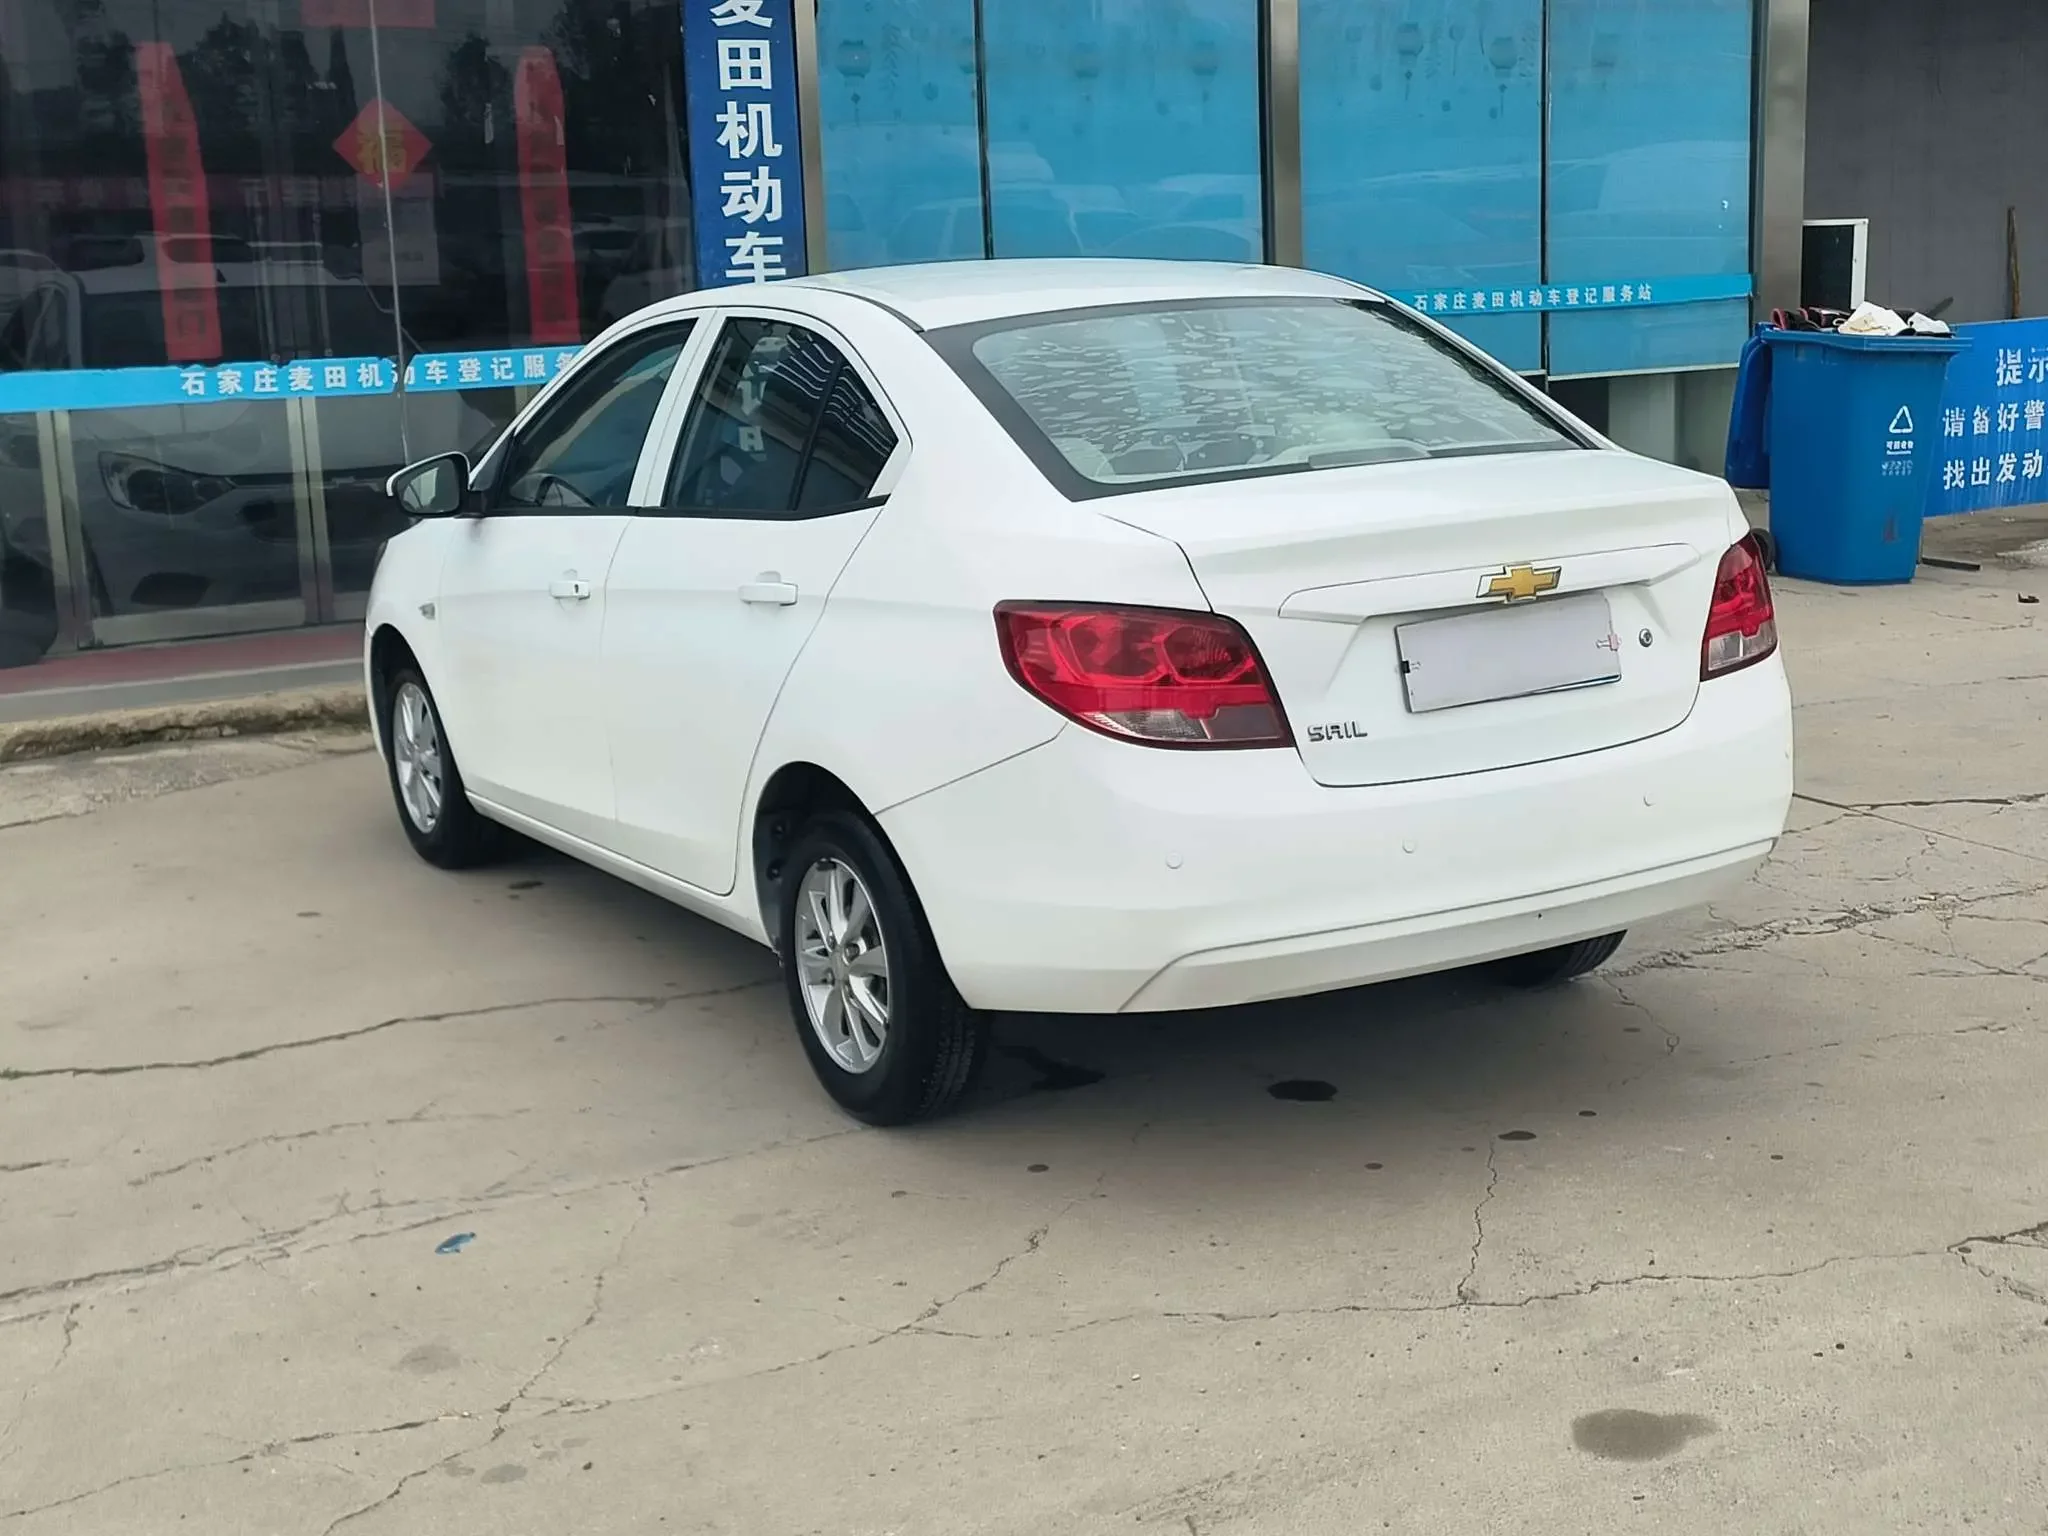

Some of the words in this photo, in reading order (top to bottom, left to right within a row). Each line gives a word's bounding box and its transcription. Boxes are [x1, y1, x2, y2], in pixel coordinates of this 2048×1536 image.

[1413, 281, 1653, 312] 石家庄麦田机动车登记服务站
[1943, 448, 2043, 490] 找出发动
[1308, 720, 1368, 742] SAIL
